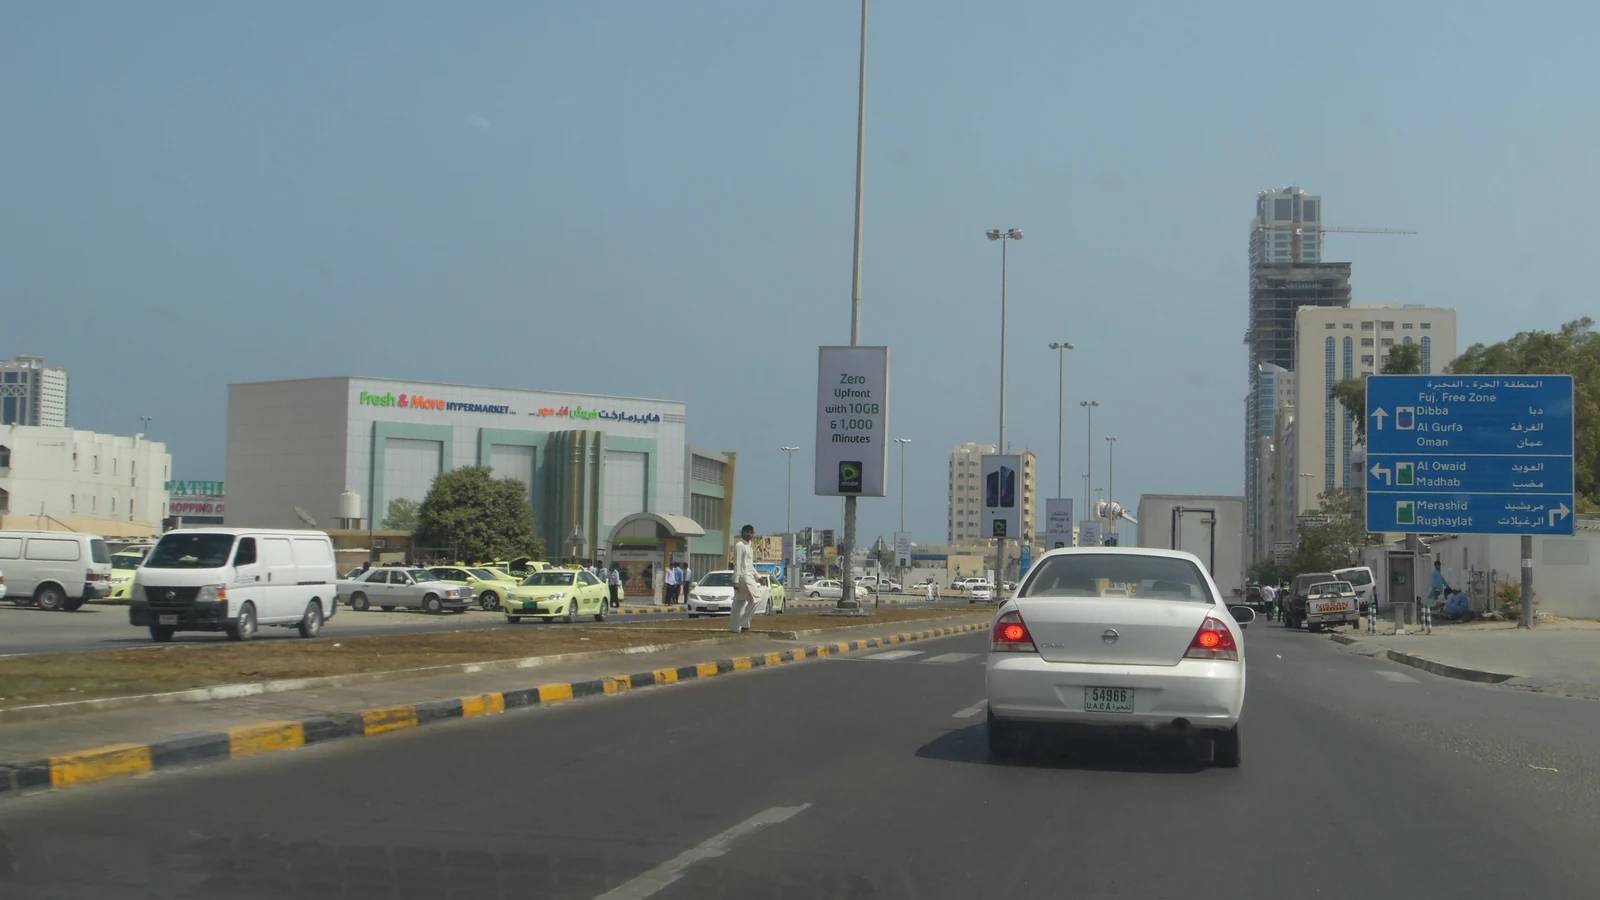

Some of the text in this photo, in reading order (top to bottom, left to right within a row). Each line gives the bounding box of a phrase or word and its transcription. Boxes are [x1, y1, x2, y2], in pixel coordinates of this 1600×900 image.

[840, 373, 866, 385] Zero
[1472, 380, 1500, 390] الحرة
[834, 388, 871, 399] Upfront
[1442, 392, 1466, 402] Free
[1469, 392, 1497, 402] Zone
[360, 391, 395, 407] Fresh
[397, 393, 408, 408] &
[411, 394, 446, 411] More
[825, 403, 880, 414] with 10GB
[1416, 406, 1449, 416] Dibba
[1529, 405, 1544, 417] دبا
[830, 419, 873, 431] & 1,000
[1416, 422, 1463, 432] Al Gurfa
[832, 434, 871, 443] Minutes
[1416, 437, 1449, 447] Oman
[1516, 437, 1544, 449] عمان
[1416, 461, 1466, 471] Al Owaid
[1416, 476, 1460, 487] Madhab
[1417, 500, 1468, 510] Merashid
[1416, 515, 1473, 526] Rughaylat
[1092, 688, 1127, 702] 54966
